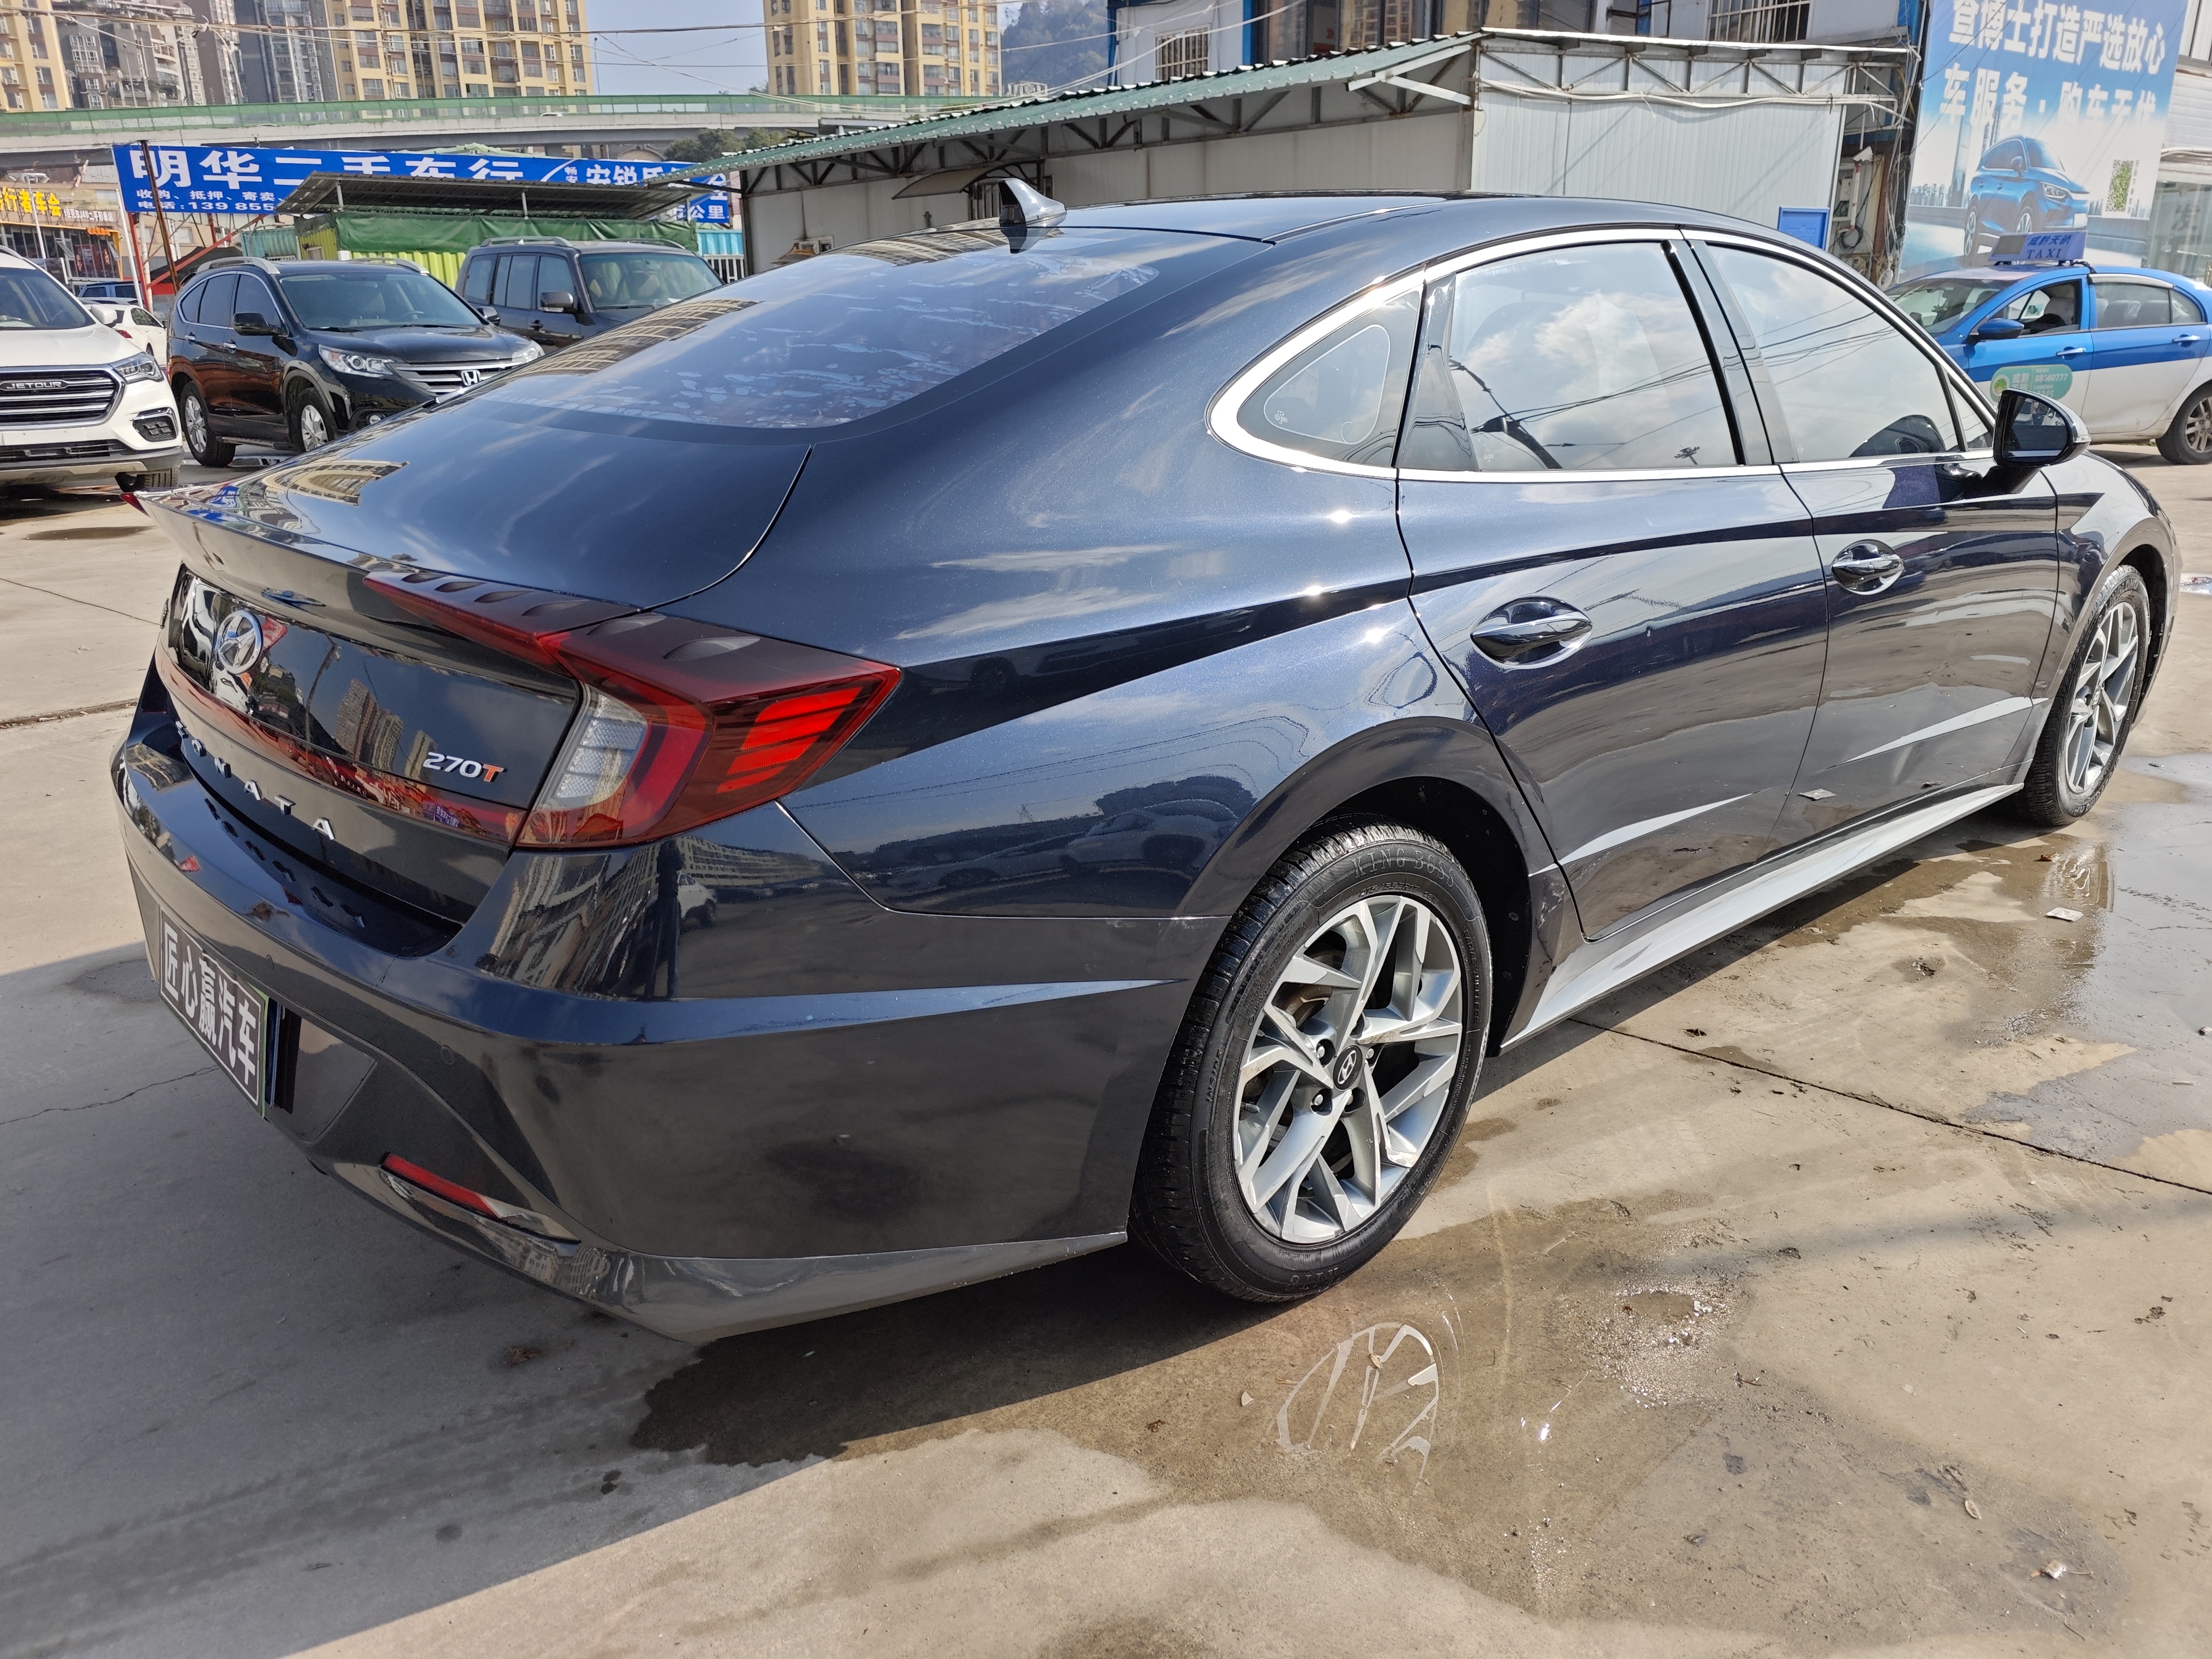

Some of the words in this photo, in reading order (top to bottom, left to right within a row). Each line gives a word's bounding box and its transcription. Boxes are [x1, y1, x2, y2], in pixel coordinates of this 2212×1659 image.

[2027, 248, 2062, 259] TAXI
[6, 381, 62, 389] JETOUR
[176, 720, 335, 841] SONATA
[423, 752, 504, 783] 270T
[1351, 848, 1405, 879] KING
[1413, 849, 1455, 887] BOSS
[164, 921, 257, 1085] 匠心赢汽车
